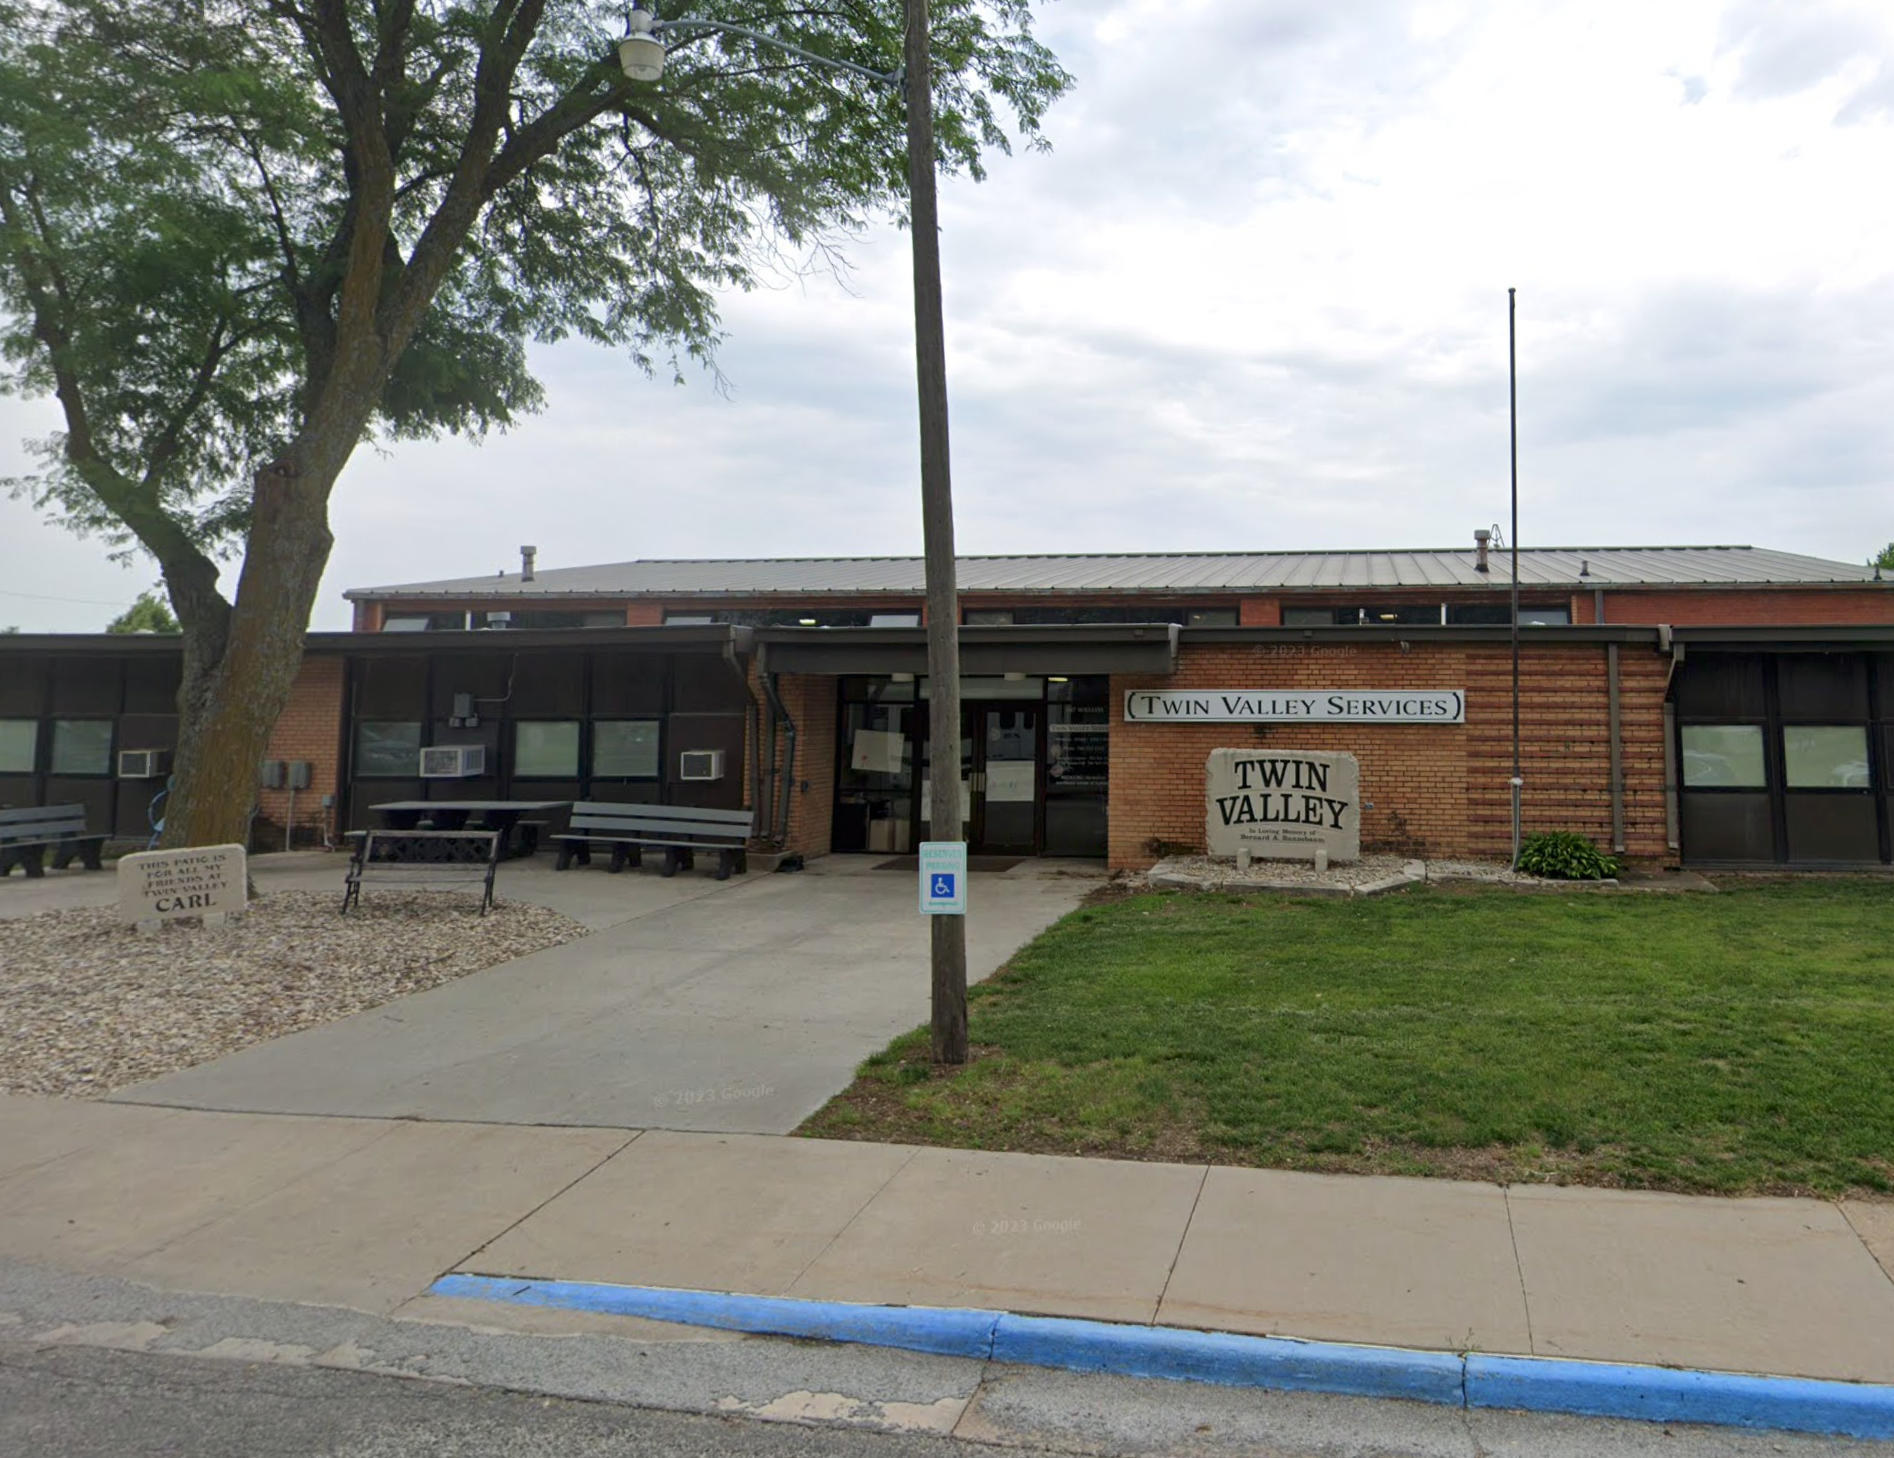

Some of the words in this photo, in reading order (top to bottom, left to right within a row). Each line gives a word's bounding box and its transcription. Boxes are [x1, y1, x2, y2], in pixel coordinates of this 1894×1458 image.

[1140, 696, 1209, 715] TWIN
[1221, 696, 1316, 715] VALLEY
[1327, 695, 1447, 715] SERVICES
[1234, 759, 1330, 792] TWIN
[1215, 793, 1348, 830] VALLEY
[139, 861, 170, 871] THIS
[174, 856, 208, 866] PATIO
[213, 854, 226, 862] IS
[923, 849, 962, 859] RESERVED
[146, 870, 173, 879] FOR
[177, 866, 201, 875] ALL
[205, 864, 222, 872] MY
[147, 875, 204, 888] FRIENDS
[209, 873, 222, 881] AT
[143, 888, 177, 897] TWIN
[183, 882, 228, 892] VALLEY
[155, 893, 217, 912] CARL
